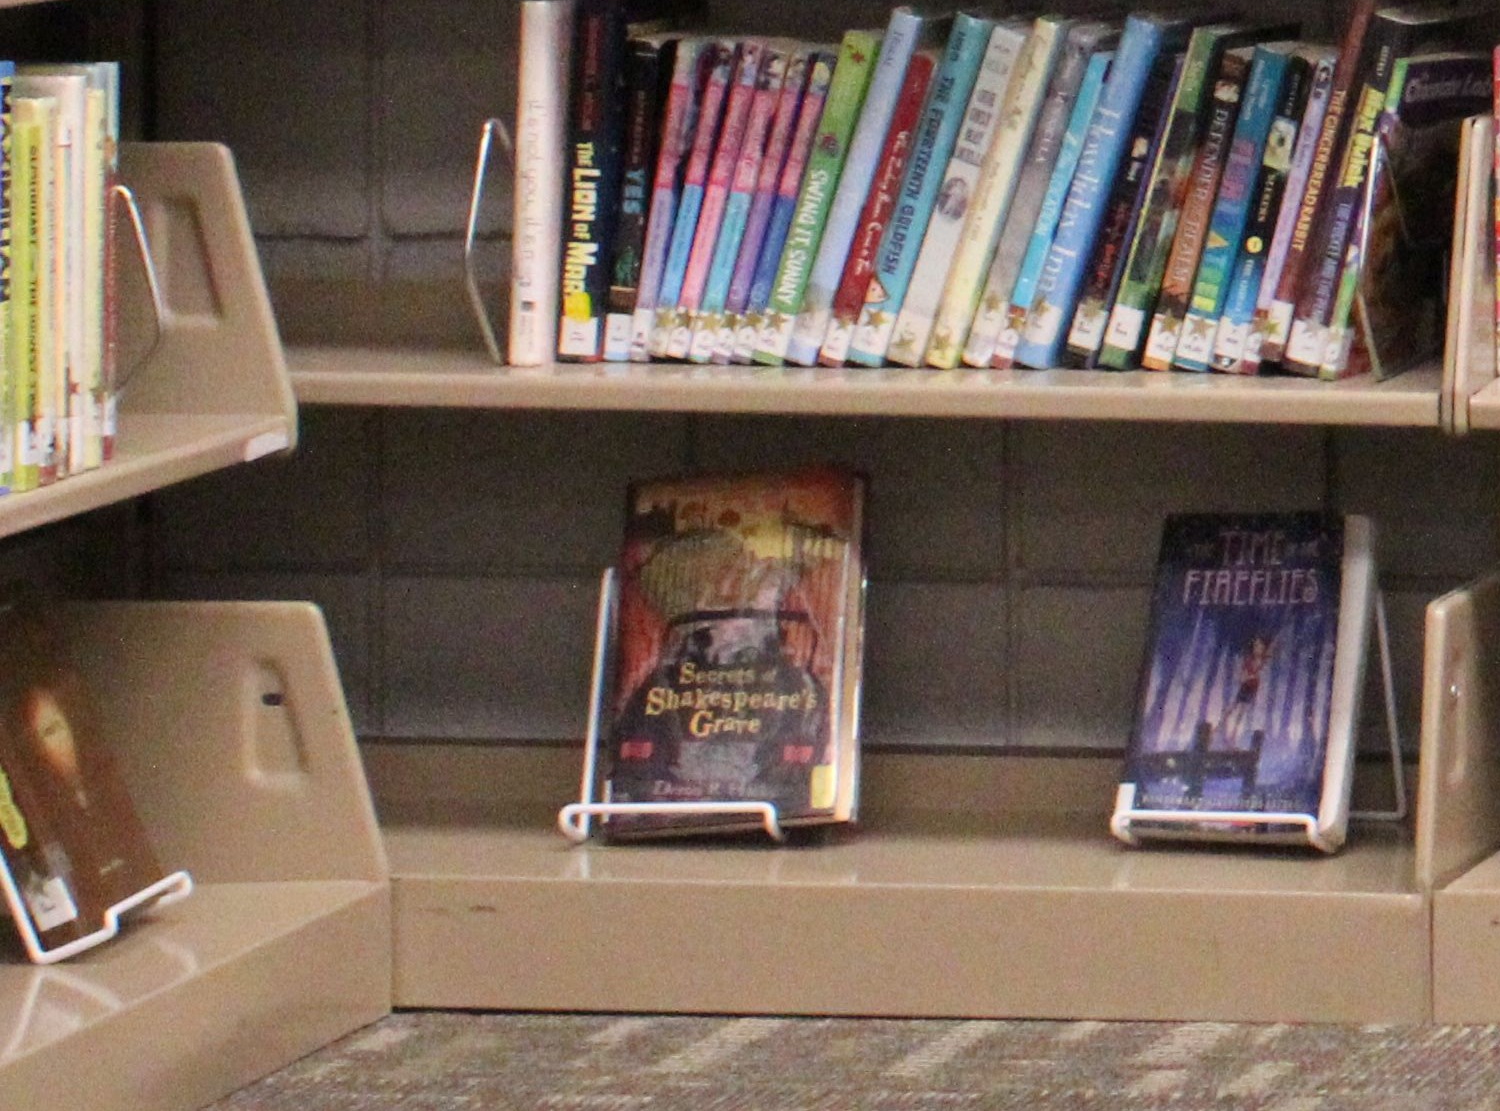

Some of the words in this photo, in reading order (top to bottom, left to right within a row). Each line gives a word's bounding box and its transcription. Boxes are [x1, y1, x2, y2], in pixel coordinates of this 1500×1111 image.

[933, 77, 954, 103] THE
[906, 108, 947, 198] FOURTEENTH
[798, 169, 828, 224] SWING
[881, 206, 914, 275] GOLDFISH
[777, 249, 805, 305] SUNNY
[1184, 568, 1319, 606] FIREFLIES
[644, 686, 818, 717] Shakespeare's
[688, 710, 761, 738] Grave
